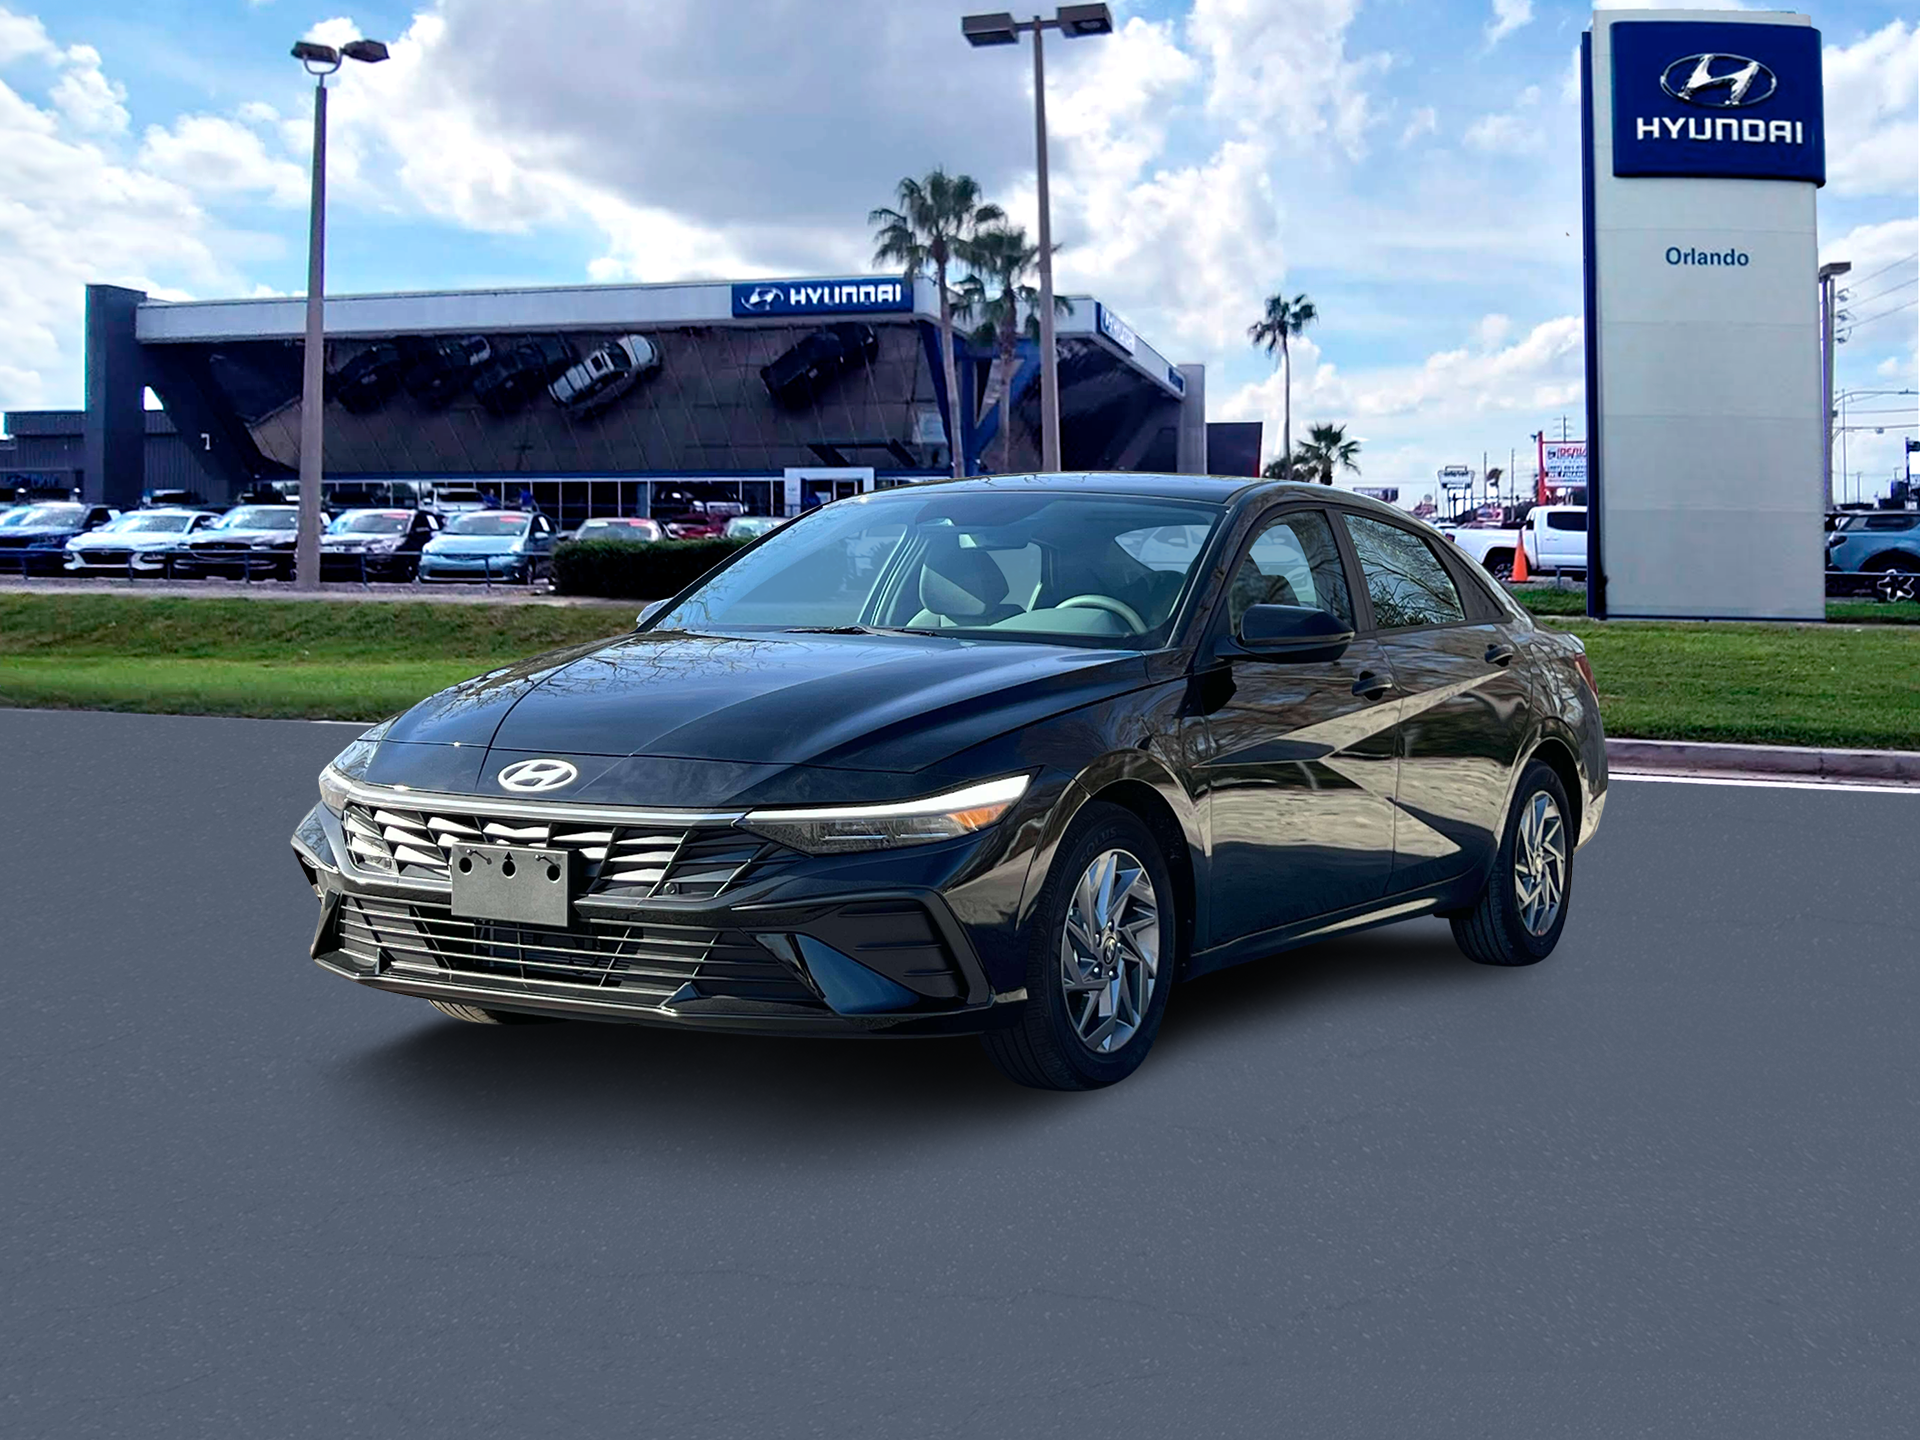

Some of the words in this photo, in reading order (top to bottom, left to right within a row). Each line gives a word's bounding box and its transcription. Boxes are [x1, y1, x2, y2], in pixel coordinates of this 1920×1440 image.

[1636, 117, 1803, 145] HYUNDAI
[1665, 247, 1750, 267] Orlando
[789, 283, 902, 307] HYUNDAI
